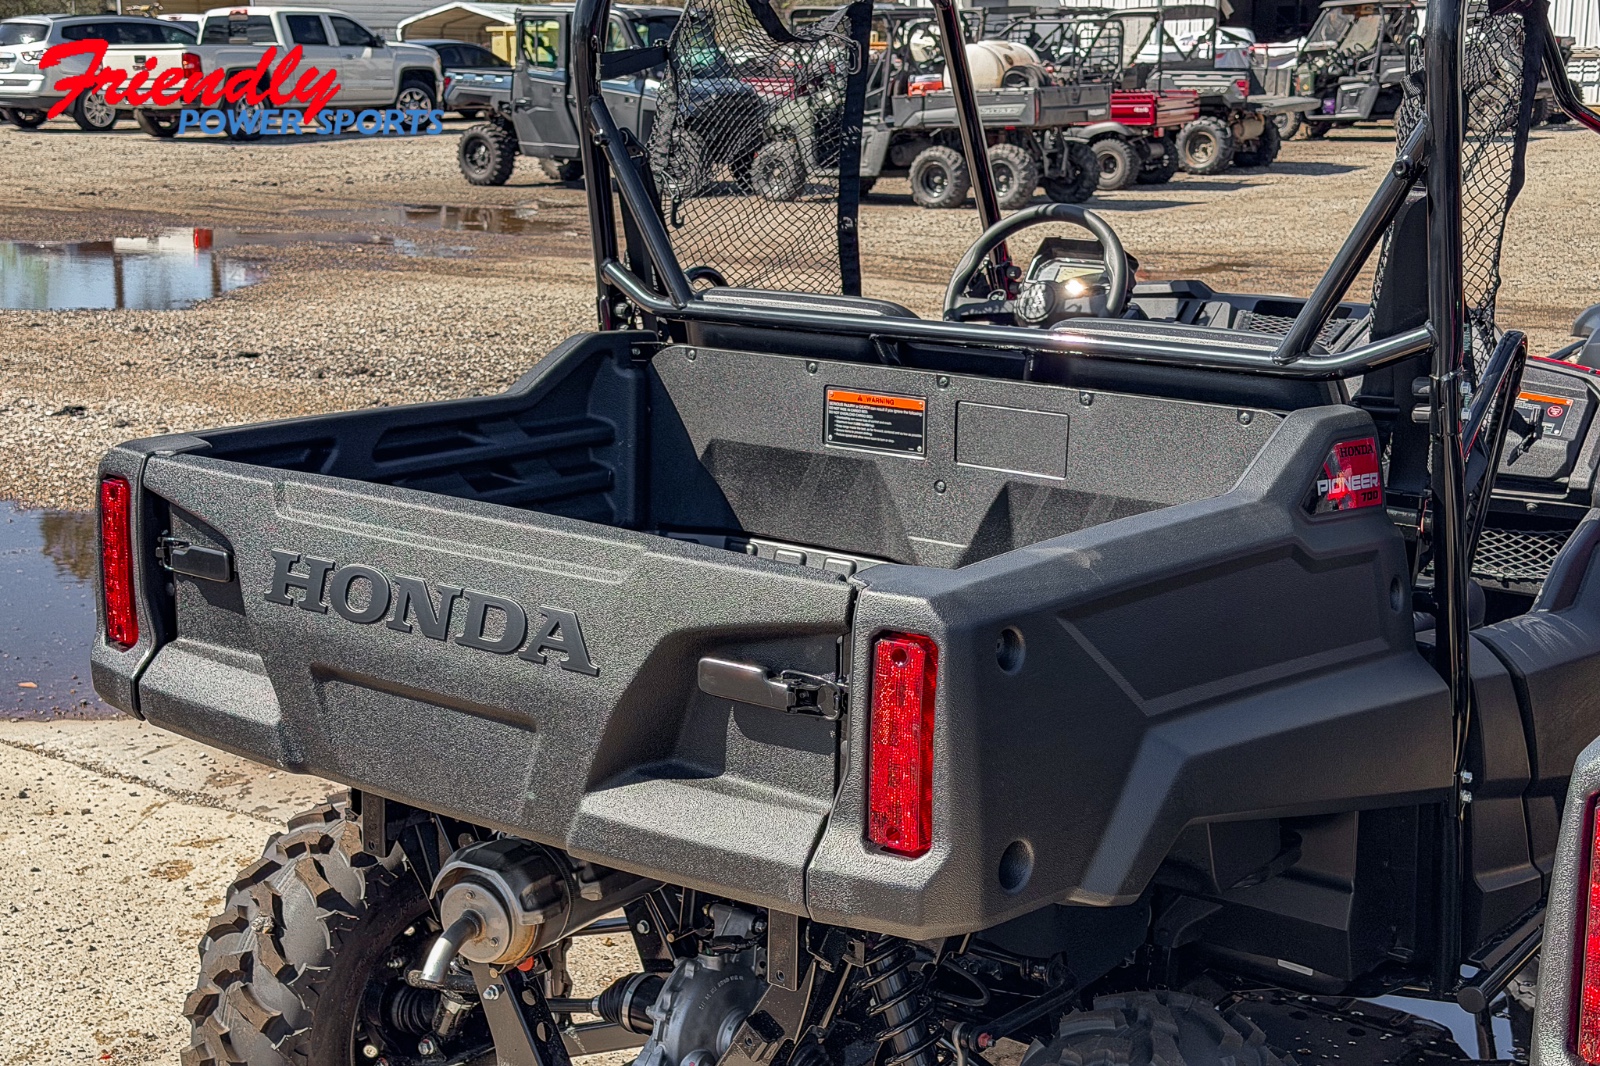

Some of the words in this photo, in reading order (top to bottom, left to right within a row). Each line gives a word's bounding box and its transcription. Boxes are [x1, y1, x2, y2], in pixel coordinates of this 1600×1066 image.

[866, 396, 895, 405] WARNING
[1340, 444, 1374, 458] HONDA
[1317, 472, 1379, 496] PIONEER
[1361, 490, 1379, 501] 700
[263, 548, 600, 677] HONDA
